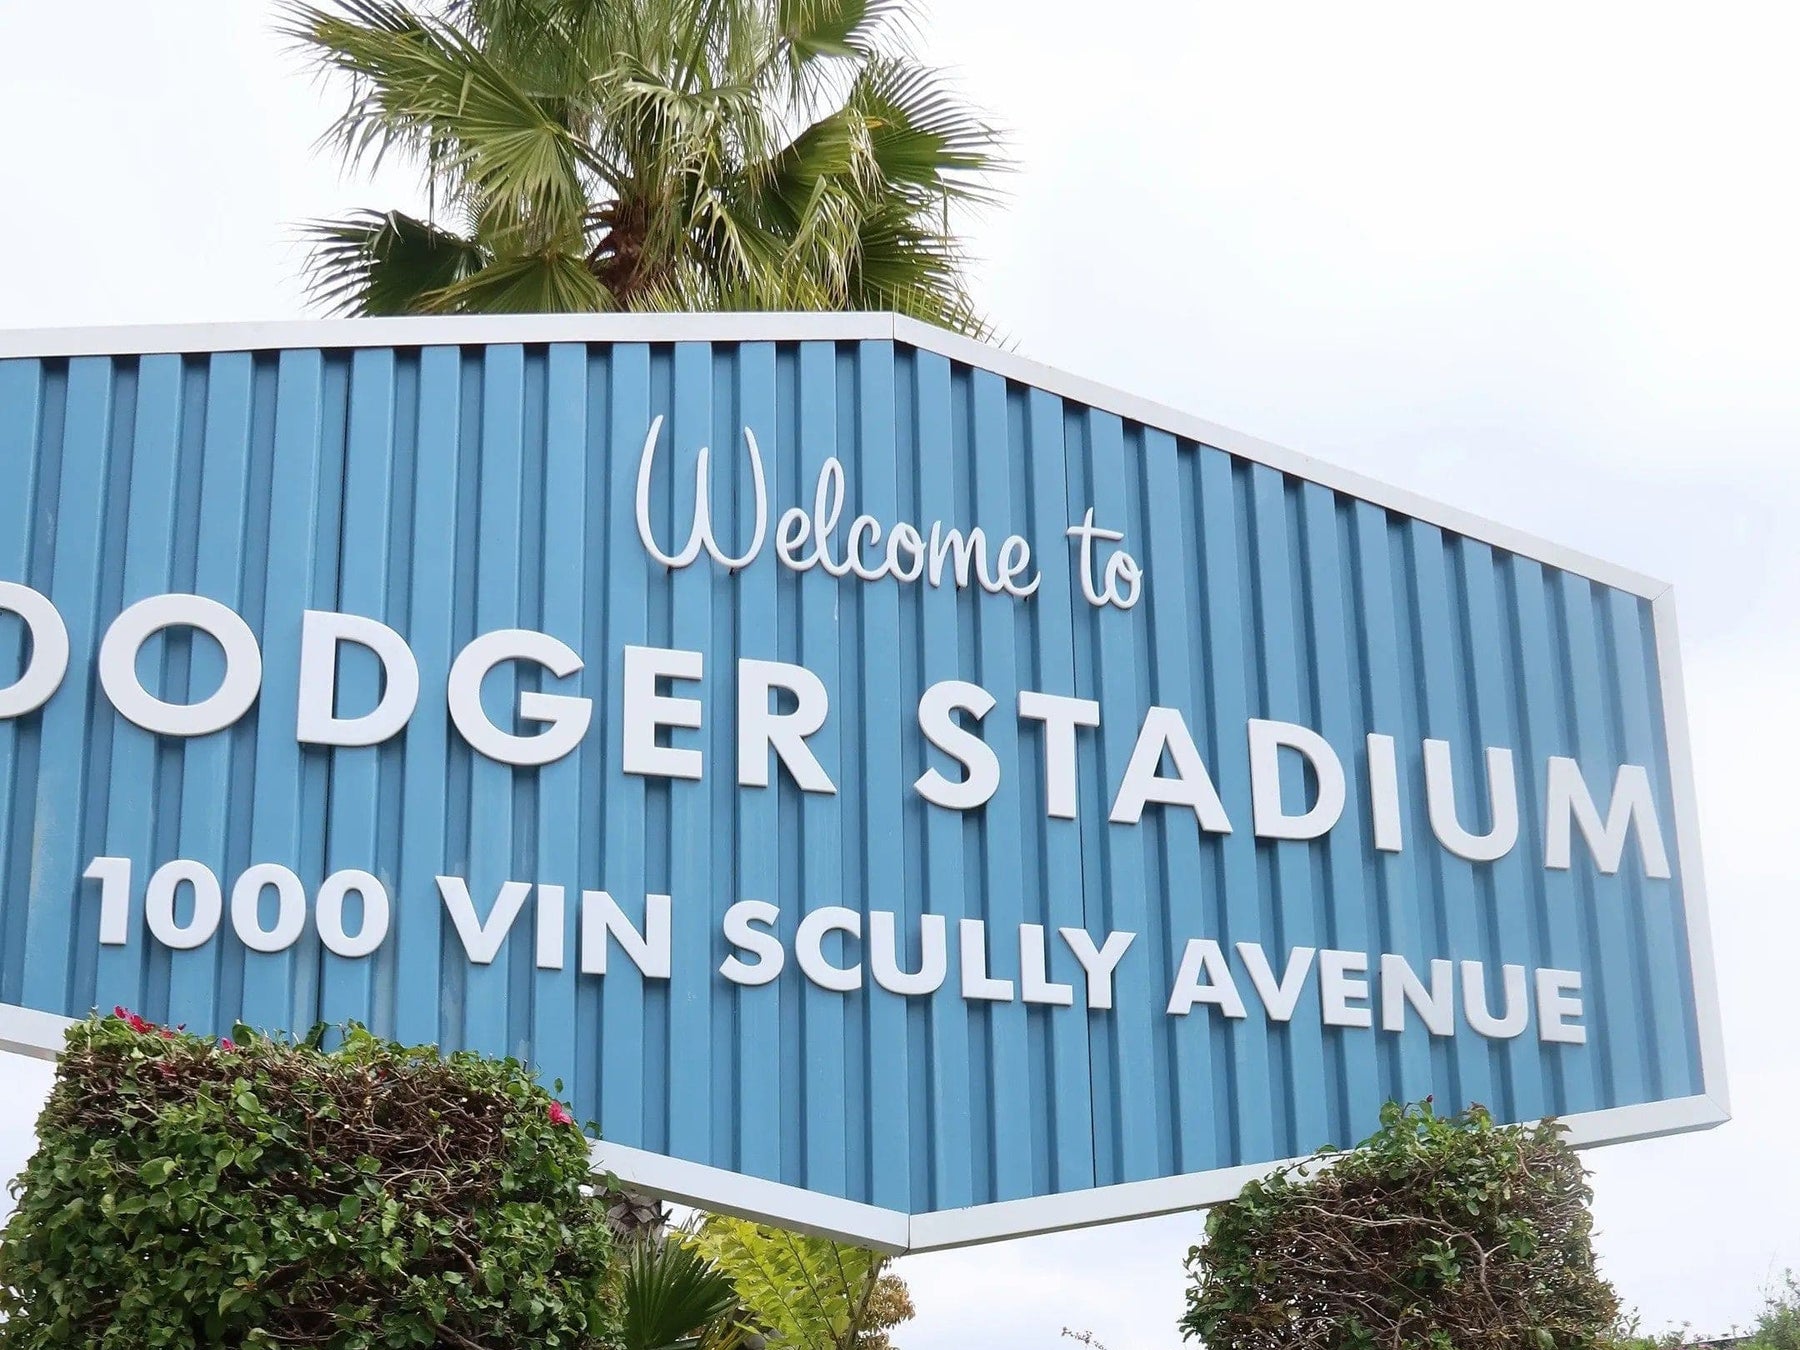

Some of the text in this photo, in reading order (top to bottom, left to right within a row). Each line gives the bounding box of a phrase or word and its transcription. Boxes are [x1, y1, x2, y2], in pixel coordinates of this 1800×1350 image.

[635, 414, 1143, 608] Welcome to
[0, 580, 1672, 880] DODGER STADIUM
[82, 856, 1587, 1045] 1000 VIN SCULLY AVENUE
